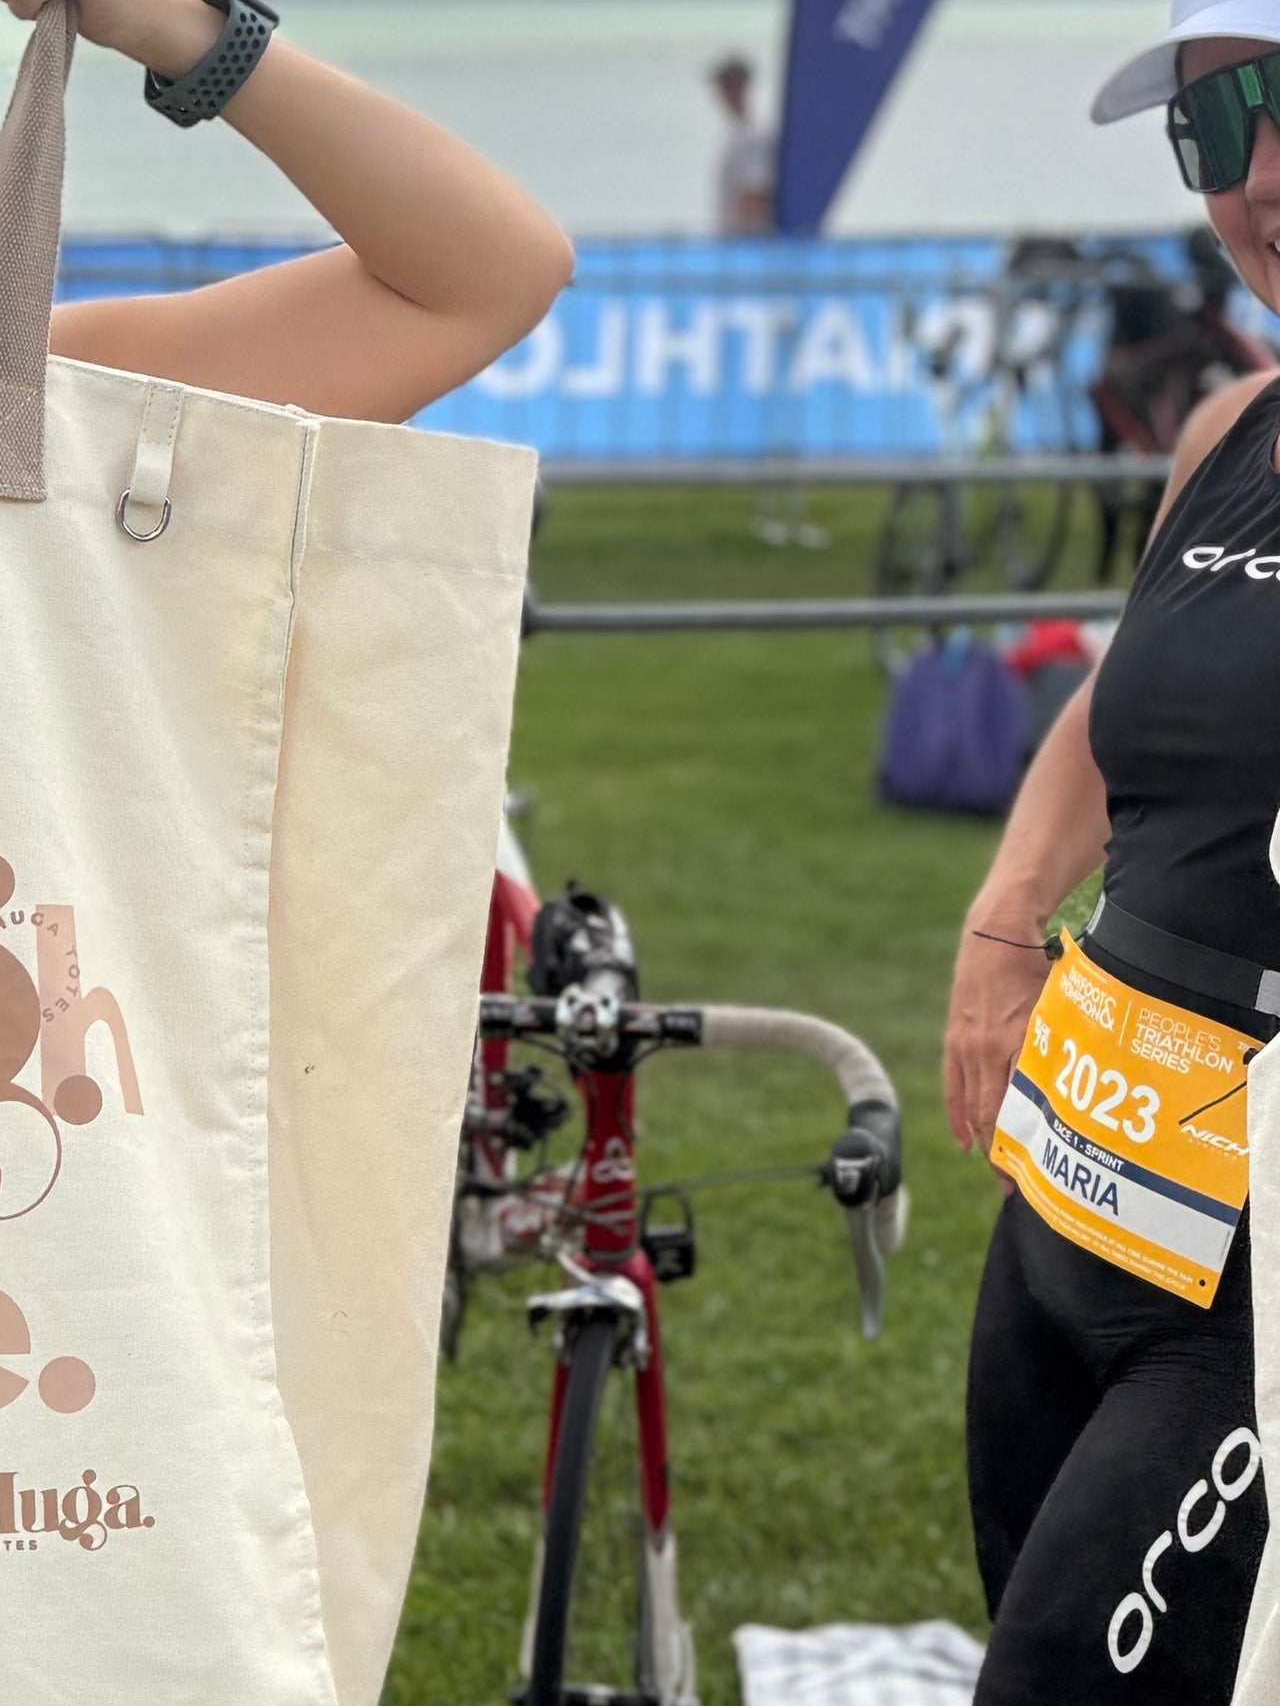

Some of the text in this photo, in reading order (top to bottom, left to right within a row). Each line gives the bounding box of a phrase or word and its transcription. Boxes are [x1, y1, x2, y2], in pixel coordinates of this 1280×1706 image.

[1135, 1022, 1234, 1074] TRIATHLON
[1137, 1007, 1222, 1052] PEOPLE'S
[1130, 1038, 1191, 1075] SERIES
[1054, 1037, 1161, 1144] 2023
[1042, 1137, 1119, 1217] MARIA
[1084, 1143, 1125, 1173] SPRINT
